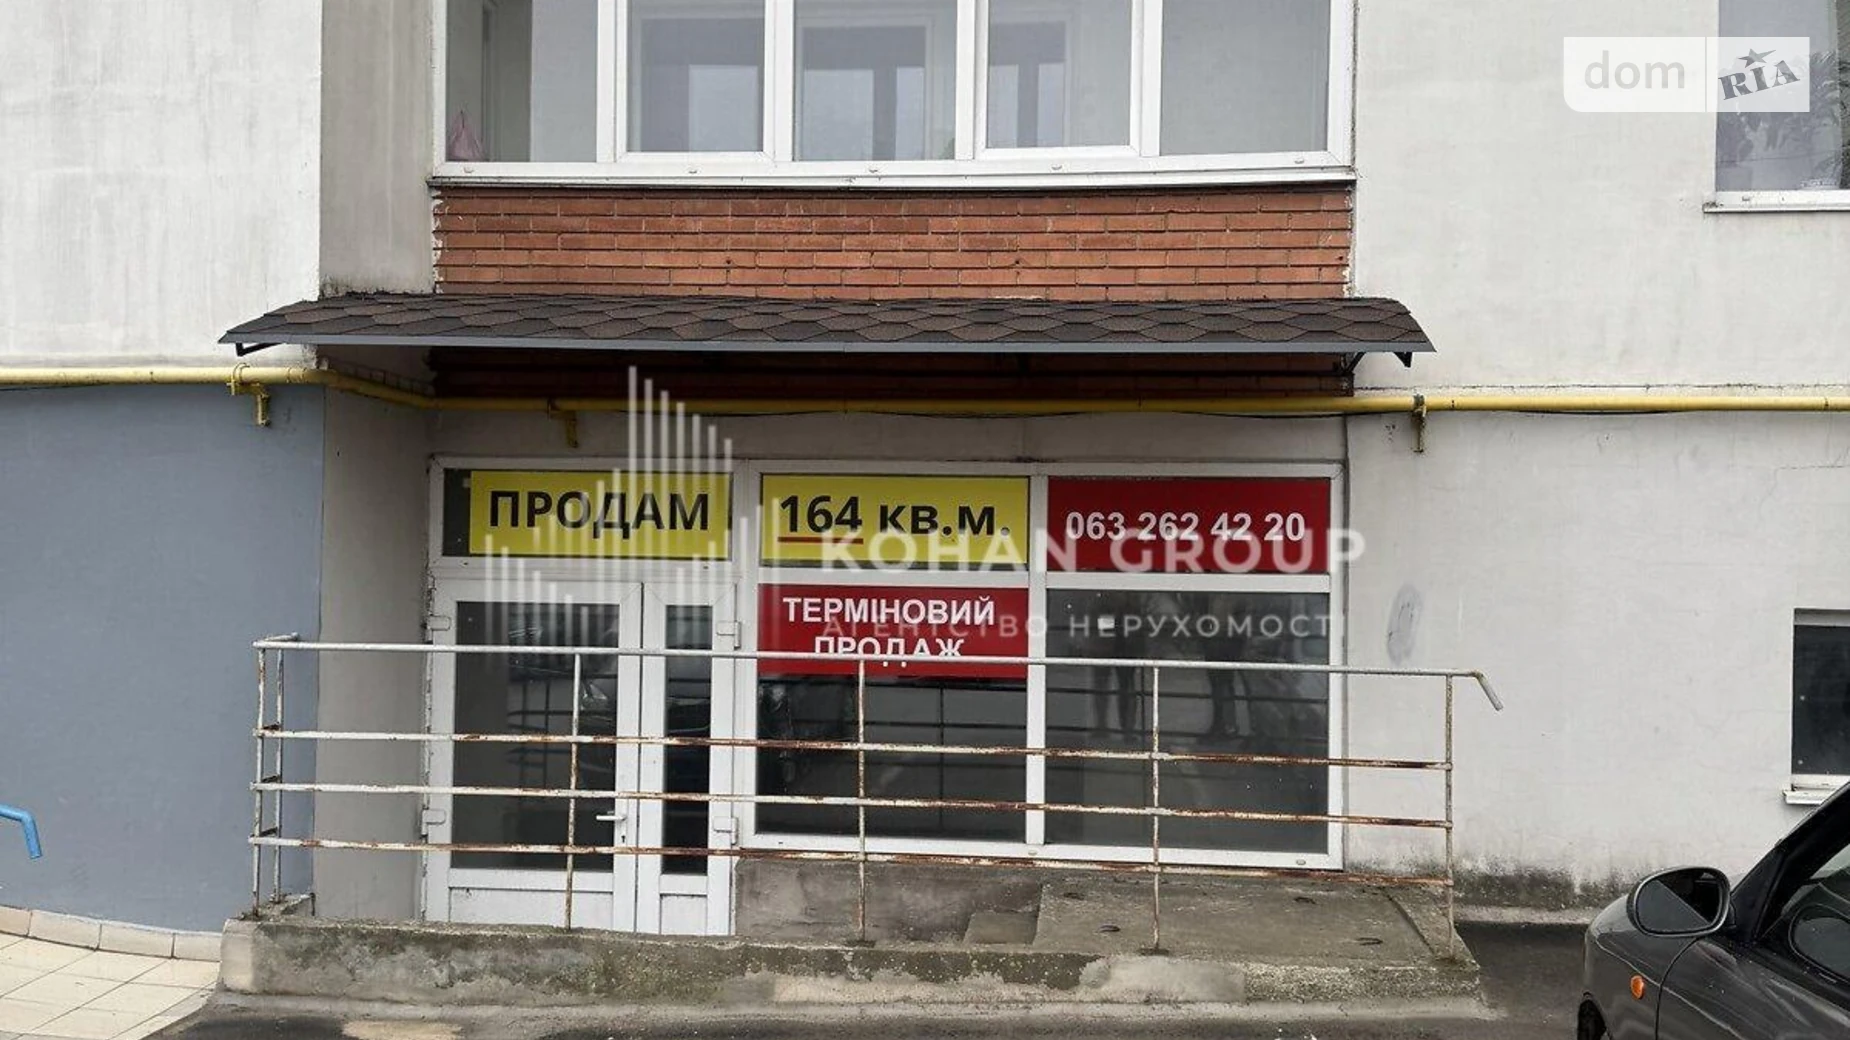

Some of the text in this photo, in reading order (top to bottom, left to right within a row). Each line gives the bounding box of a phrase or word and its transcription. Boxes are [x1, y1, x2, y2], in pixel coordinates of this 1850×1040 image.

[489, 489, 710, 540] ПРОДАМ
[779, 494, 863, 533] 164
[1066, 511, 1306, 541] 063 262 42 20
[783, 596, 996, 625] ТЕРМІНОВИЙ
[814, 636, 965, 667] ПРОДАЖ
